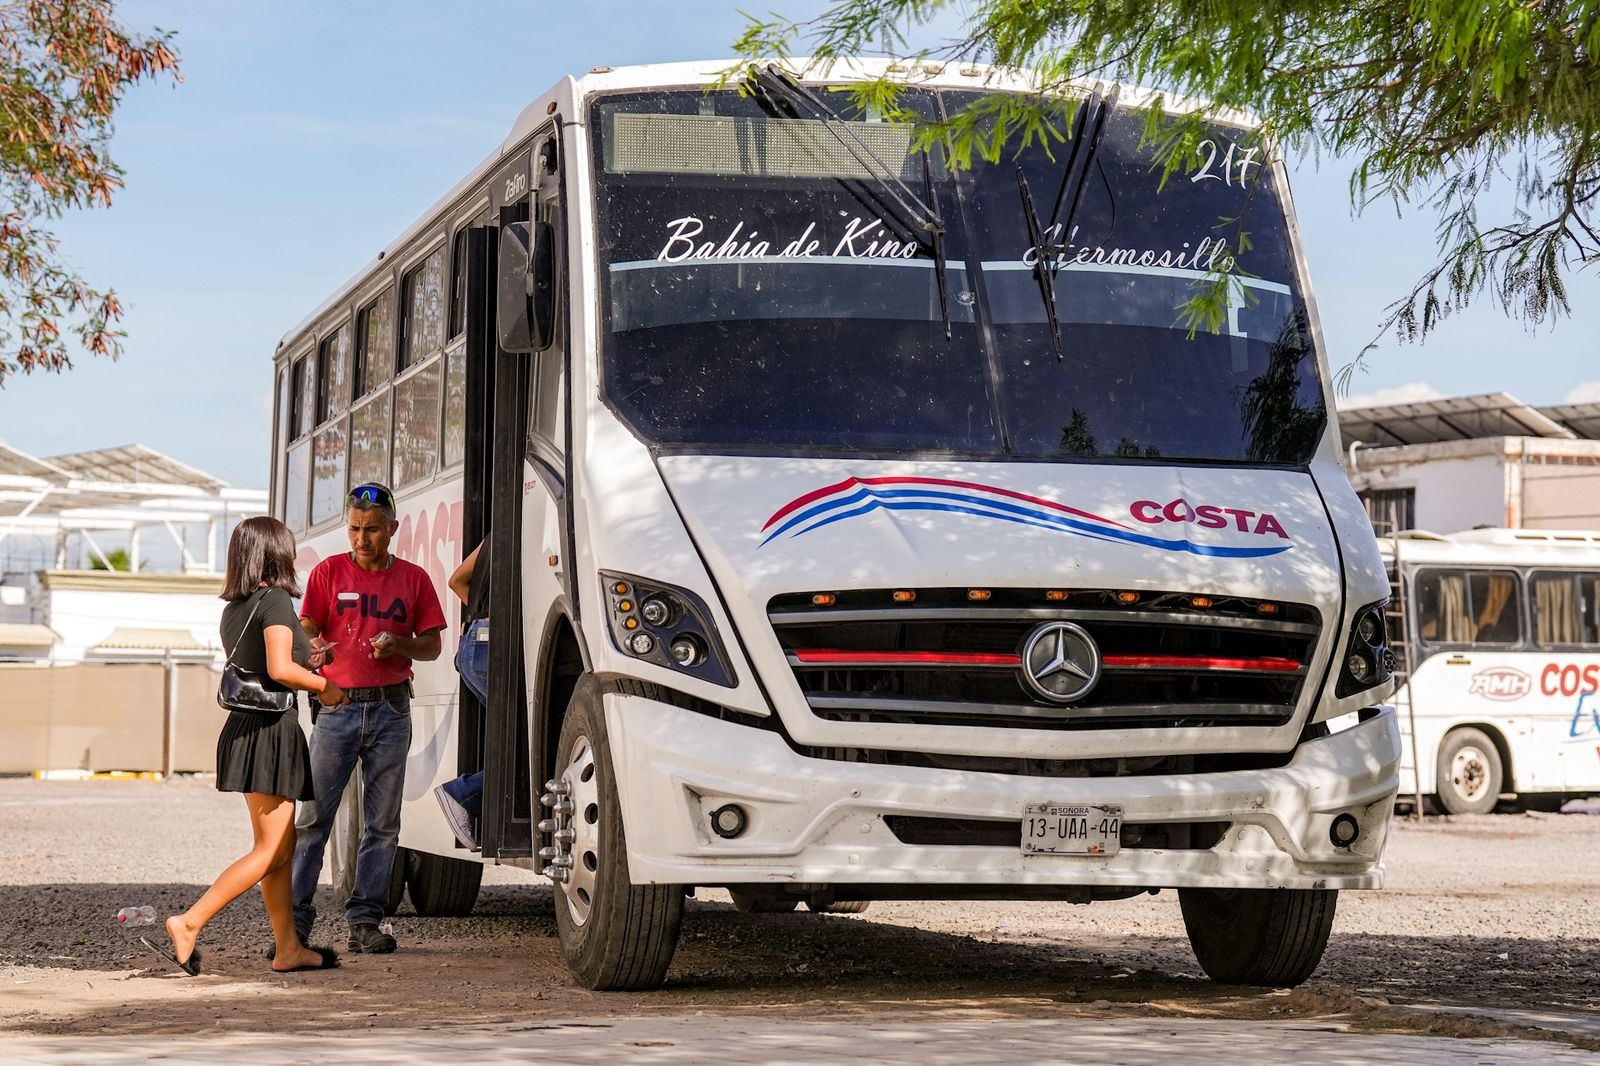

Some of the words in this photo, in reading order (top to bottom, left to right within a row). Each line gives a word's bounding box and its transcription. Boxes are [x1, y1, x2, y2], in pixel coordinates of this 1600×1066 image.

[1191, 139, 1261, 189] 217
[776, 221, 820, 259] de
[832, 216, 918, 259] Kino
[1129, 498, 1290, 540] COSTA
[336, 592, 407, 623] FILA
[1029, 818, 1119, 839] 13-UAA-44
